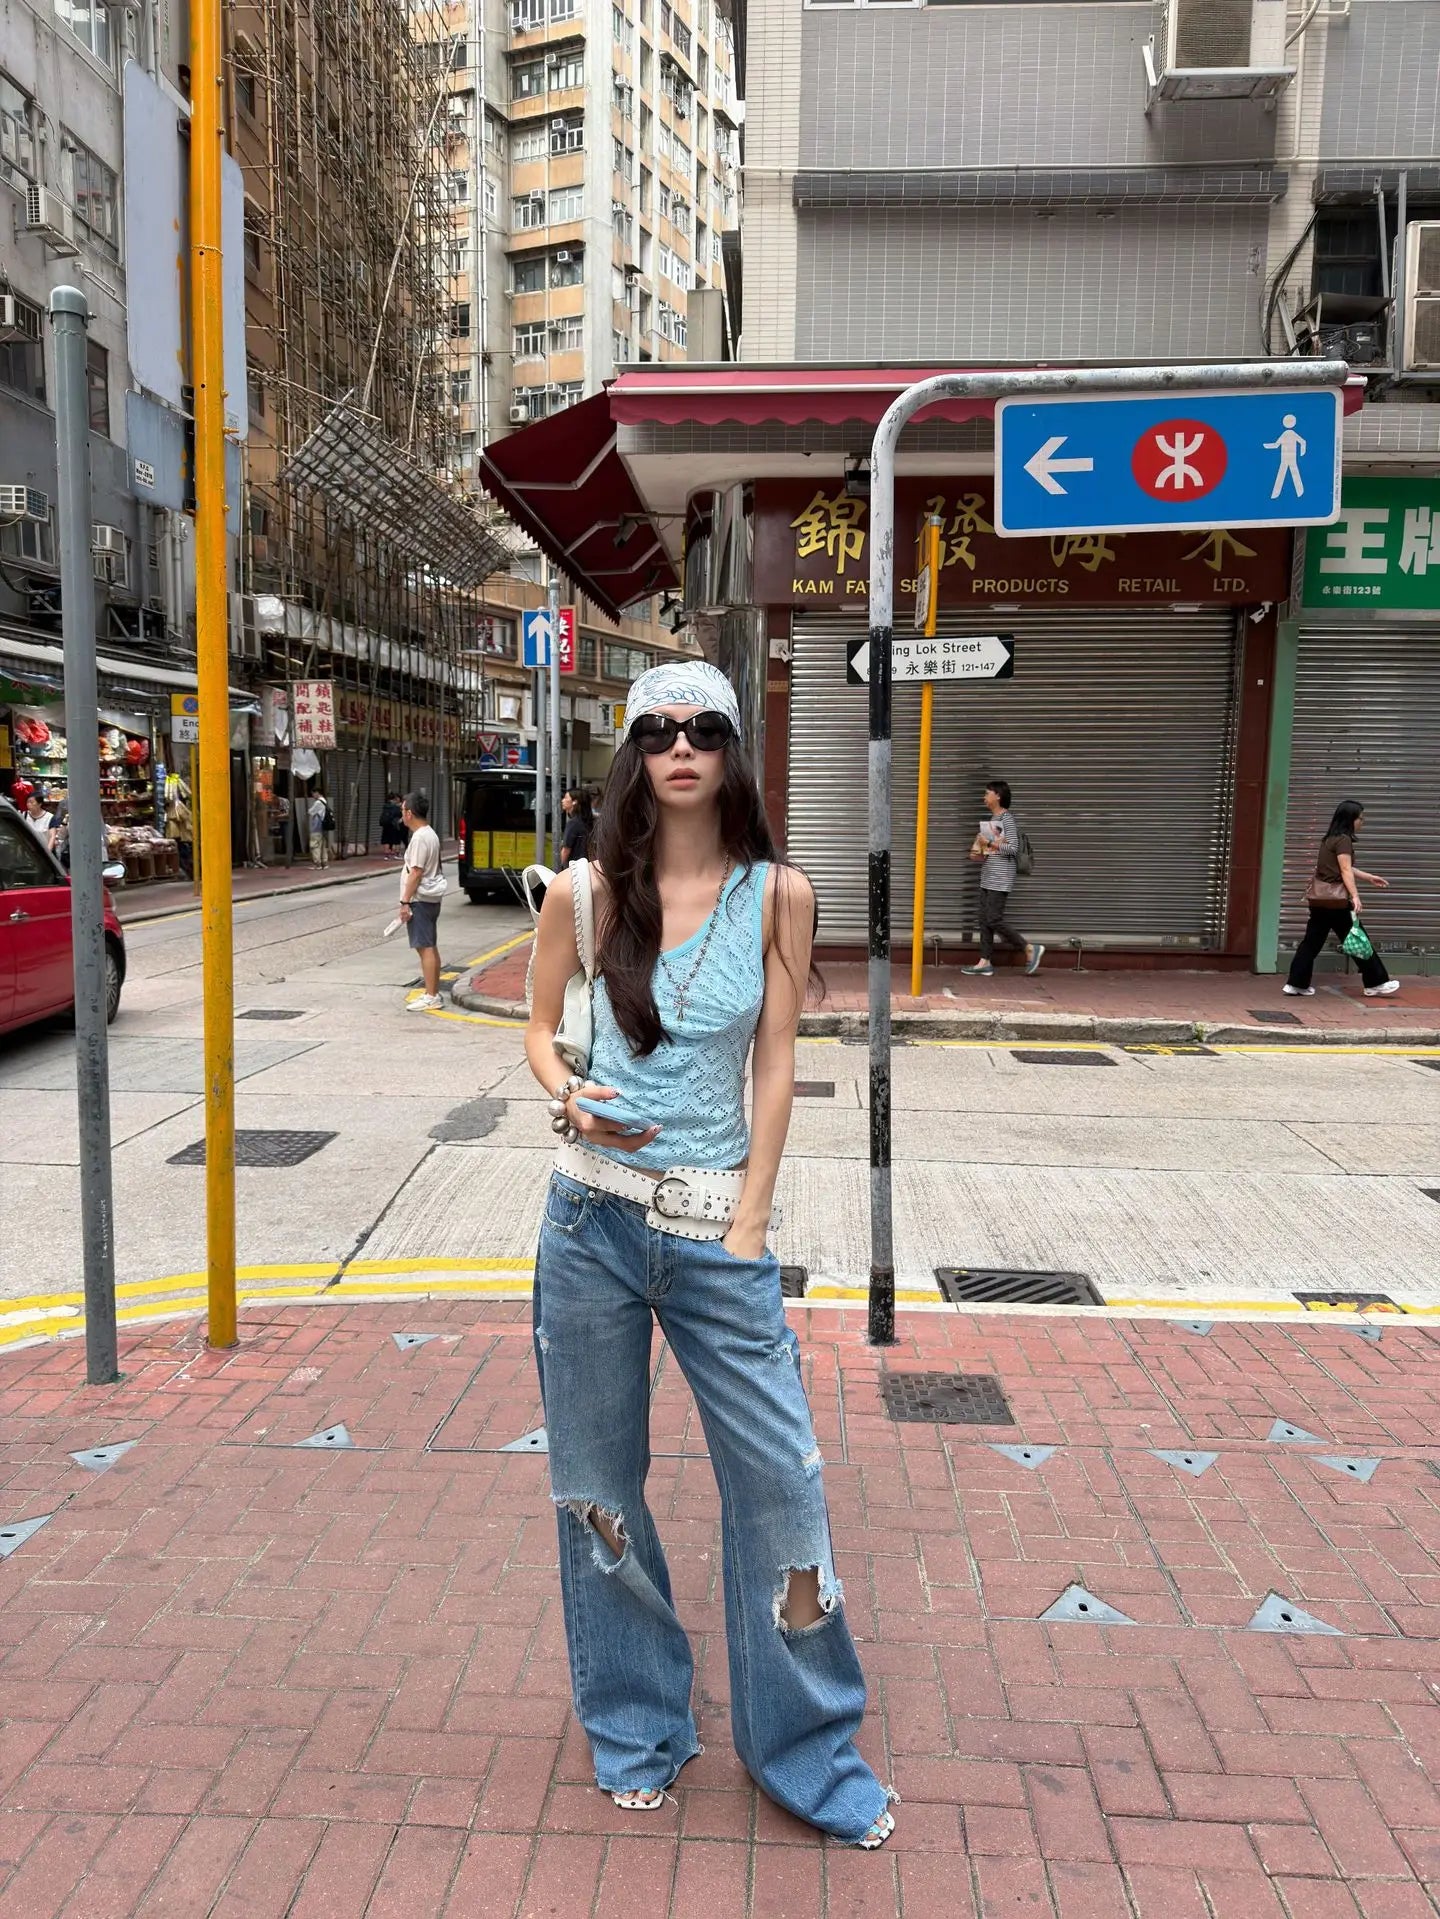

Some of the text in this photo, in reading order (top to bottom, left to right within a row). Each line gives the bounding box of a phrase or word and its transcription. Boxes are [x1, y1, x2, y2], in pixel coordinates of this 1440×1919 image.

[792, 578, 1250, 594] KAM FA SE PRODUCTS RETAIL LTD.
[892, 641, 982, 657] ing Lok Street
[905, 659, 956, 675] 永樂街
[961, 662, 996, 672] 121-147
